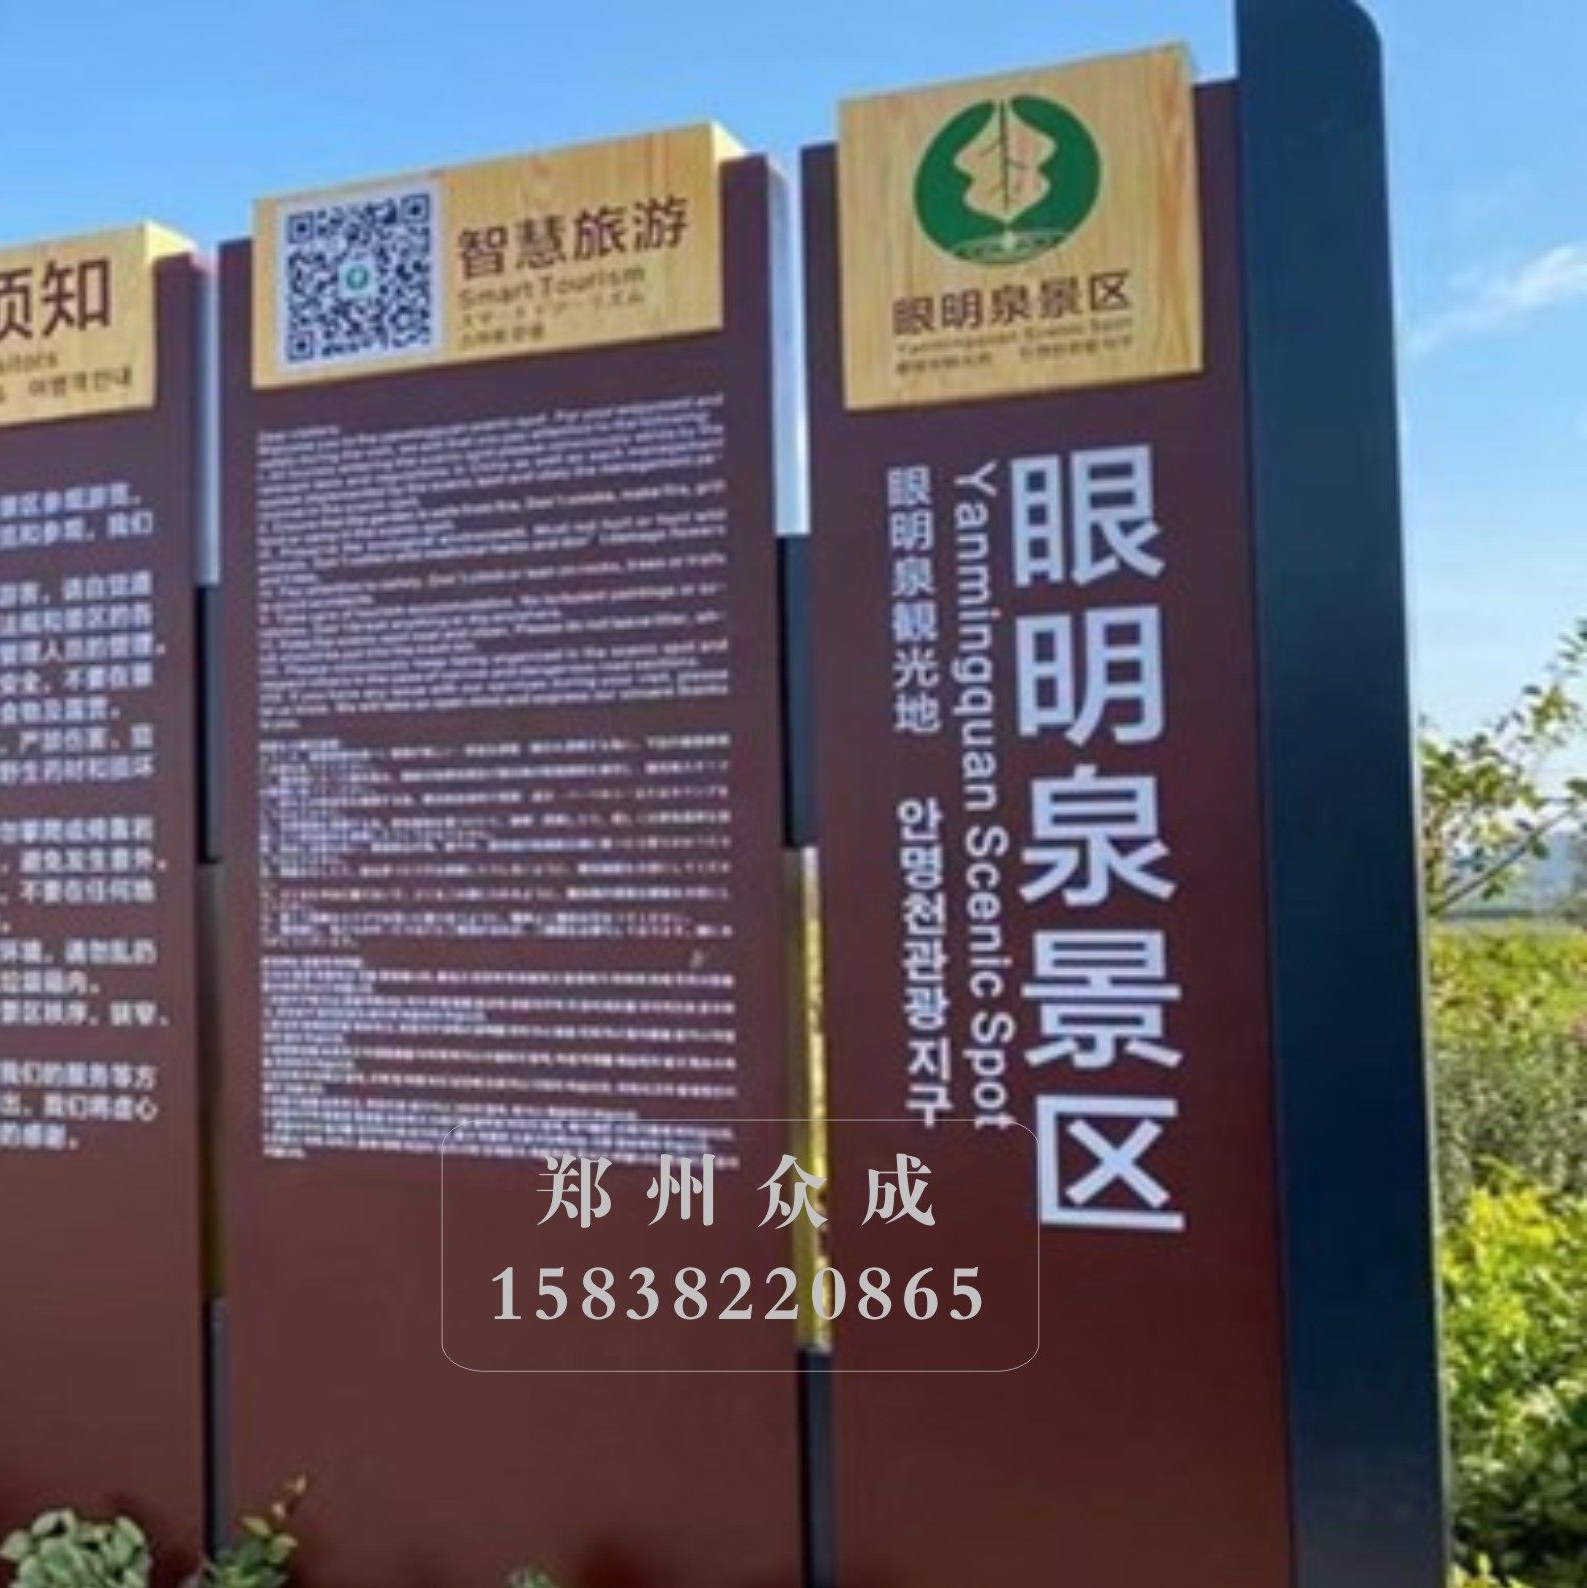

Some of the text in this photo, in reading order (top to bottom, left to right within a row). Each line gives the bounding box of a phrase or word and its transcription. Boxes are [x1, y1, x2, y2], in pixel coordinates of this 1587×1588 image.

[458, 194, 690, 281] 智慧旅游
[458, 280, 533, 310] Smart
[892, 268, 1131, 336] 眼明泉景区
[950, 460, 1017, 1130] Yanmingquan Scenic Spot
[1009, 444, 1187, 1233] 眼明泉景区
